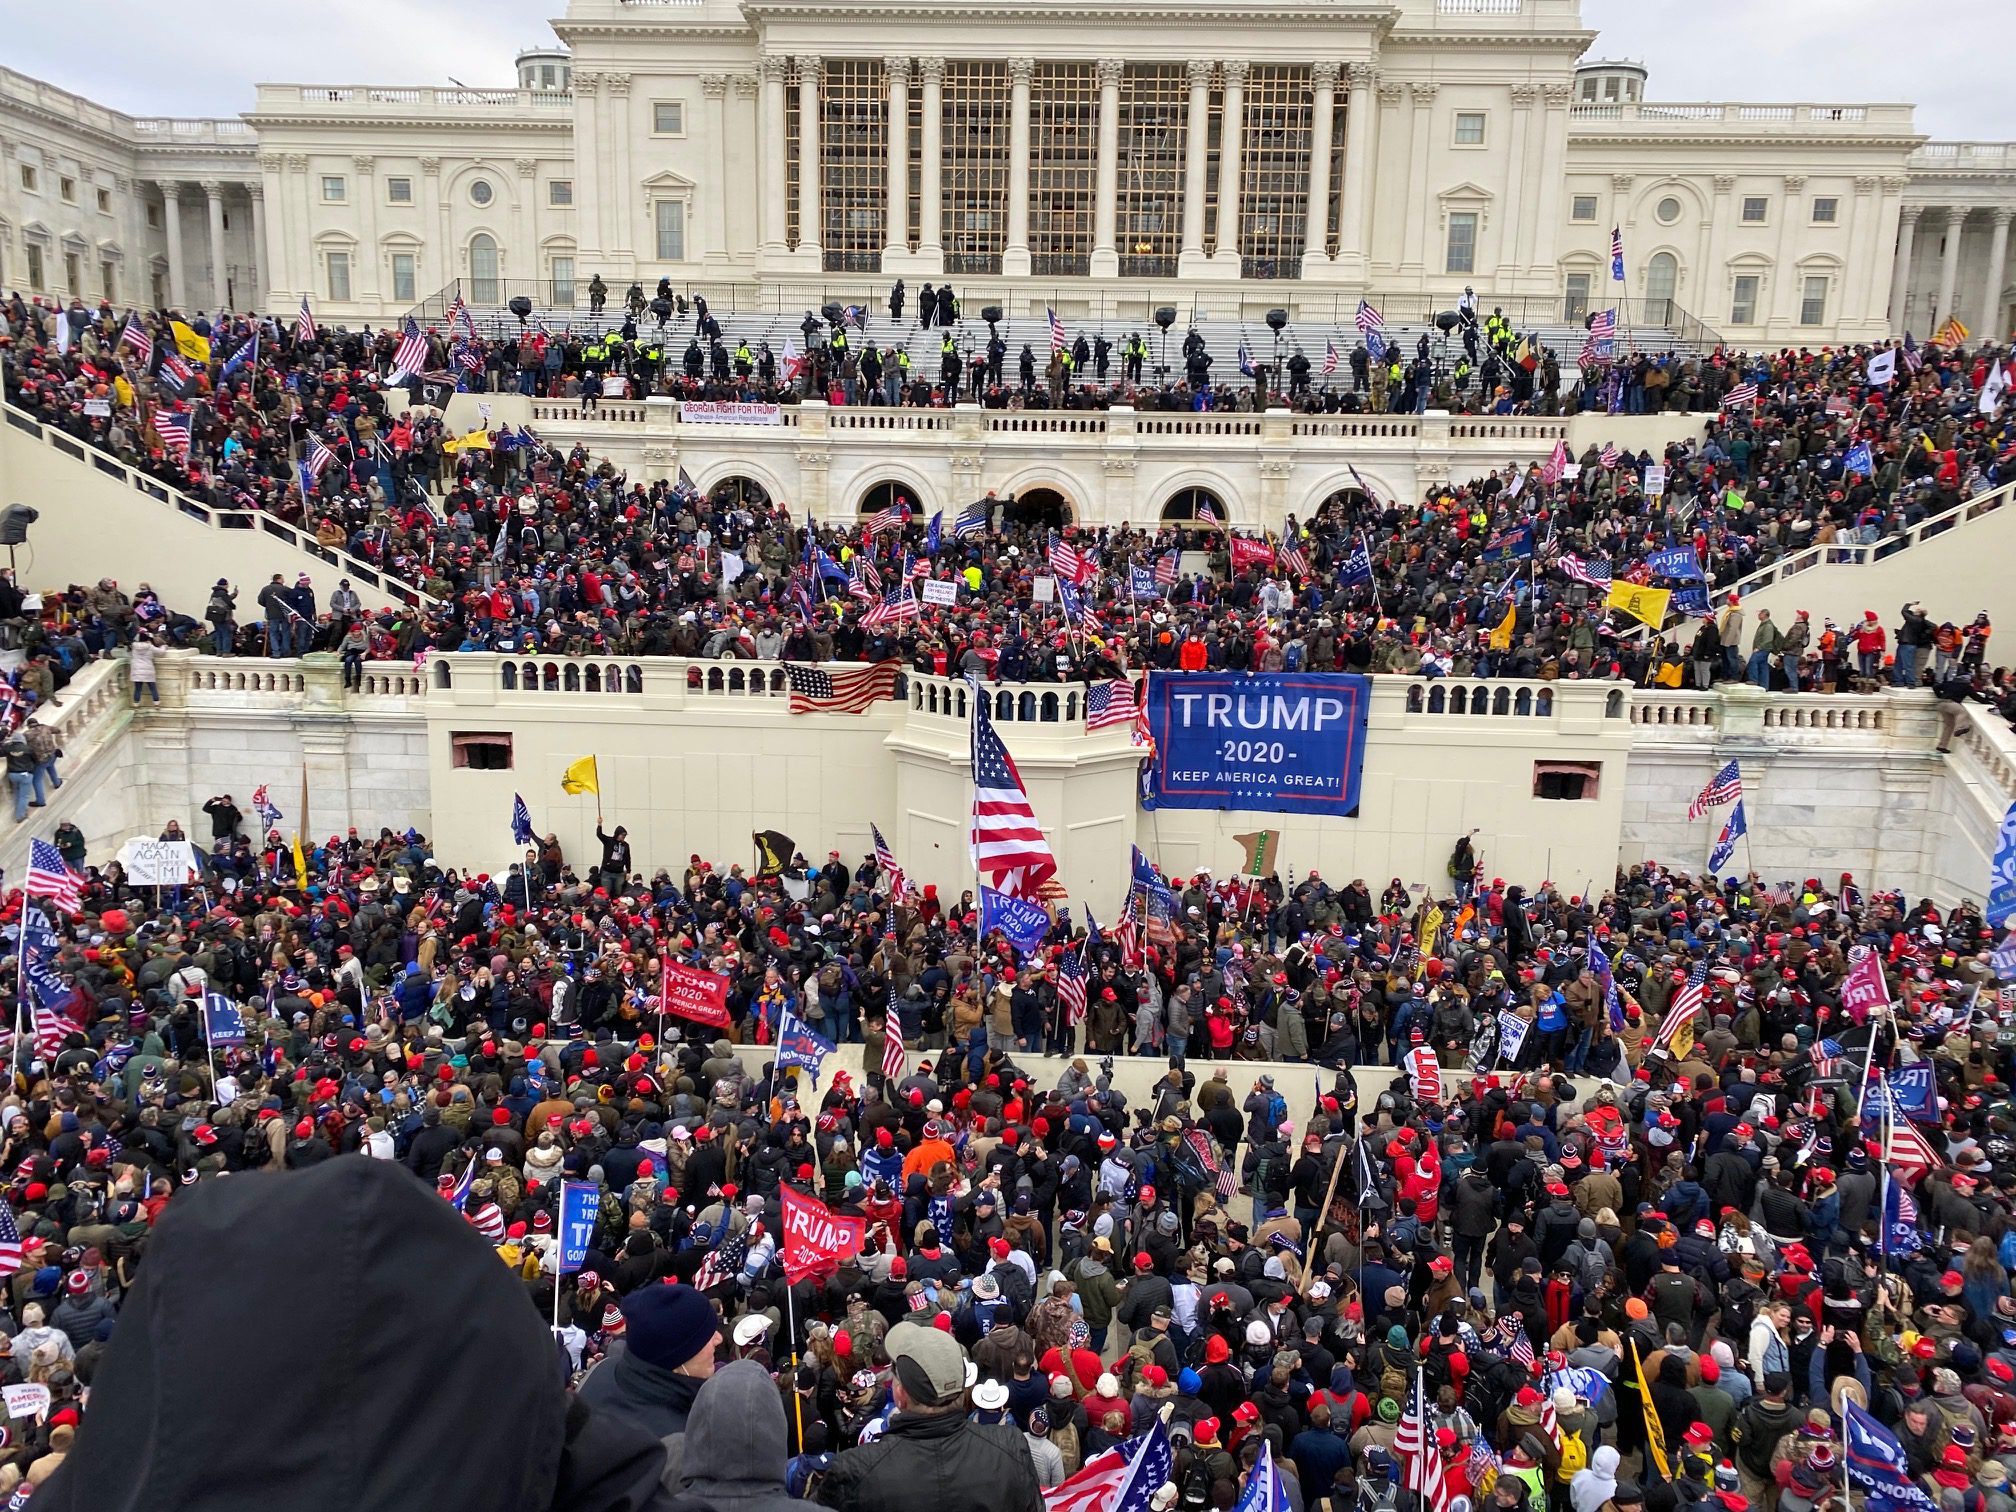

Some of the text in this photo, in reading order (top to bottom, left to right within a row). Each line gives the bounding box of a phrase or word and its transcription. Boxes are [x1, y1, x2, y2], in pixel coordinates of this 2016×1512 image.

[684, 403, 777, 415] GEORGIA FIGHT FOR TRUMP
[1237, 542, 1270, 557] TRUMP
[1173, 692, 1343, 732] TRUMP
[1172, 769, 1339, 788] KEEP AMERICA GREAT!
[133, 850, 180, 860] AGAIN
[141, 842, 170, 851] MAGA
[163, 866, 180, 877] MI
[989, 893, 1047, 928] TRUMP
[669, 972, 718, 993] TRUMP
[671, 985, 708, 1002] -2020-
[666, 996, 722, 1018] AMERICA GREAT!
[1500, 1013, 1527, 1033] ELECTION
[211, 1030, 235, 1040] KEEP
[784, 1201, 852, 1253] TRUMP
[12, 1402, 37, 1411] GREAT
[1849, 1467, 1876, 1487] NO
